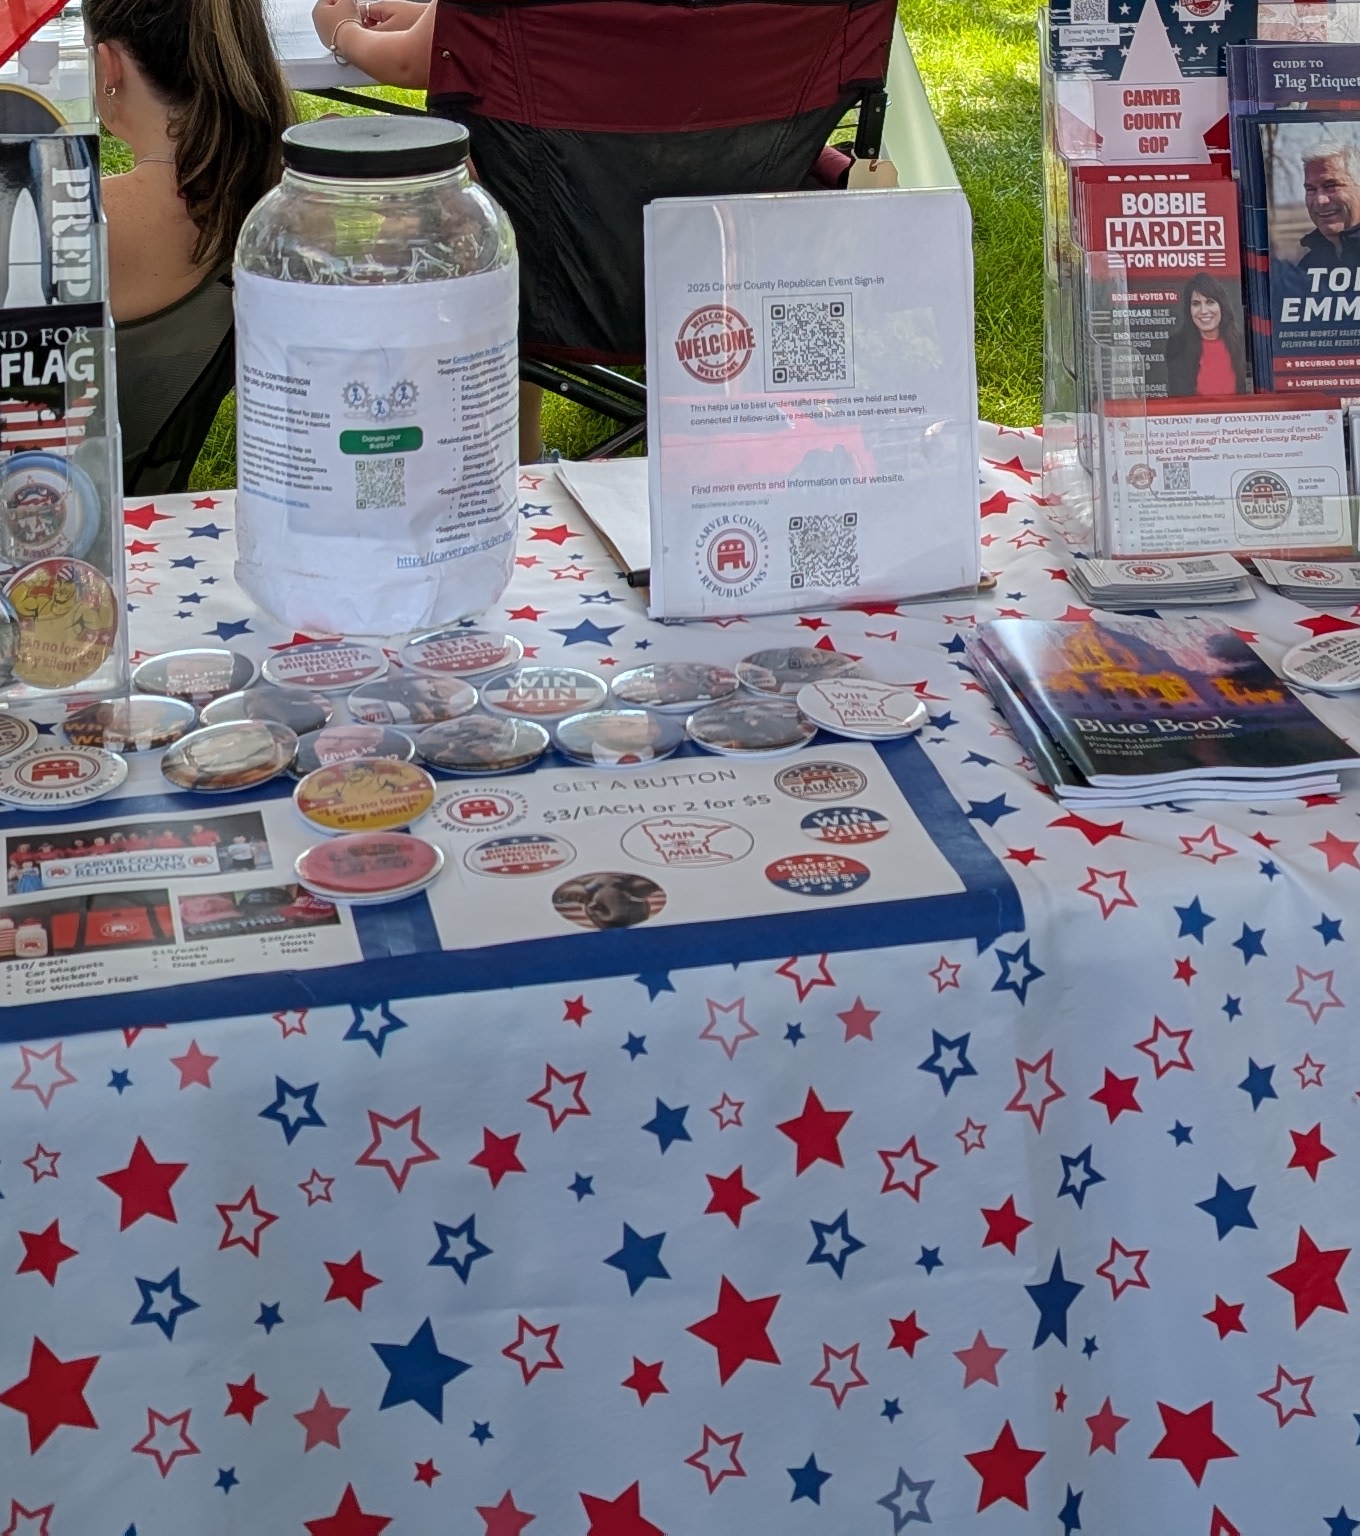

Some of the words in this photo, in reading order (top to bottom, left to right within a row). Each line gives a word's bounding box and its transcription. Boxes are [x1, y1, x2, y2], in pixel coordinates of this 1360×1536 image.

[1273, 60, 1306, 68] GUIDE
[1308, 60, 1324, 68] TO
[1274, 74, 1307, 92] Flag
[1123, 89, 1180, 106] CARVER
[1123, 112, 1182, 130] COUNTY
[1138, 136, 1169, 154] GOP
[1122, 192, 1206, 215] BOBBIE
[1109, 221, 1224, 248] HARDER
[1127, 253, 1154, 267] FOR
[1158, 253, 1206, 267] HOUSE
[687, 283, 710, 293] 2025
[713, 281, 741, 292] Carver
[744, 280, 776, 291] County
[778, 278, 827, 289] Republican
[828, 278, 853, 287] Event
[854, 276, 884, 287] Sign-in
[1140, 293, 1163, 301] VOTES
[40, 326, 91, 347] FOR
[675, 327, 756, 361] WELCOME
[1, 347, 95, 388] FLAG
[1222, 428, 1264, 436] Participate
[691, 485, 711, 495] Find
[713, 484, 735, 493] more
[737, 481, 766, 492] events
[768, 480, 785, 489] and
[787, 478, 838, 489] information
[869, 474, 904, 484] website.
[1244, 504, 1286, 515] CAUCUS
[700, 570, 768, 598] REPUBLICANS
[1300, 636, 1346, 653] VOTE
[278, 654, 371, 672] MINNESOTA
[505, 676, 578, 688] WIN
[505, 688, 578, 701] MIN
[831, 692, 868, 700] WIN
[1071, 718, 1150, 735] Blue
[1150, 715, 1243, 733] Book
[552, 781, 599, 793] GET
[611, 779, 628, 791] A
[633, 769, 737, 790] BUTTON
[791, 781, 858, 794] CAUCUS
[543, 804, 644, 824] $3/EACH
[653, 803, 676, 813] or
[703, 797, 736, 809] for
[812, 812, 871, 828] WIN
[658, 829, 695, 842] WIN
[821, 823, 878, 839] MIN
[669, 848, 703, 859] MIN
